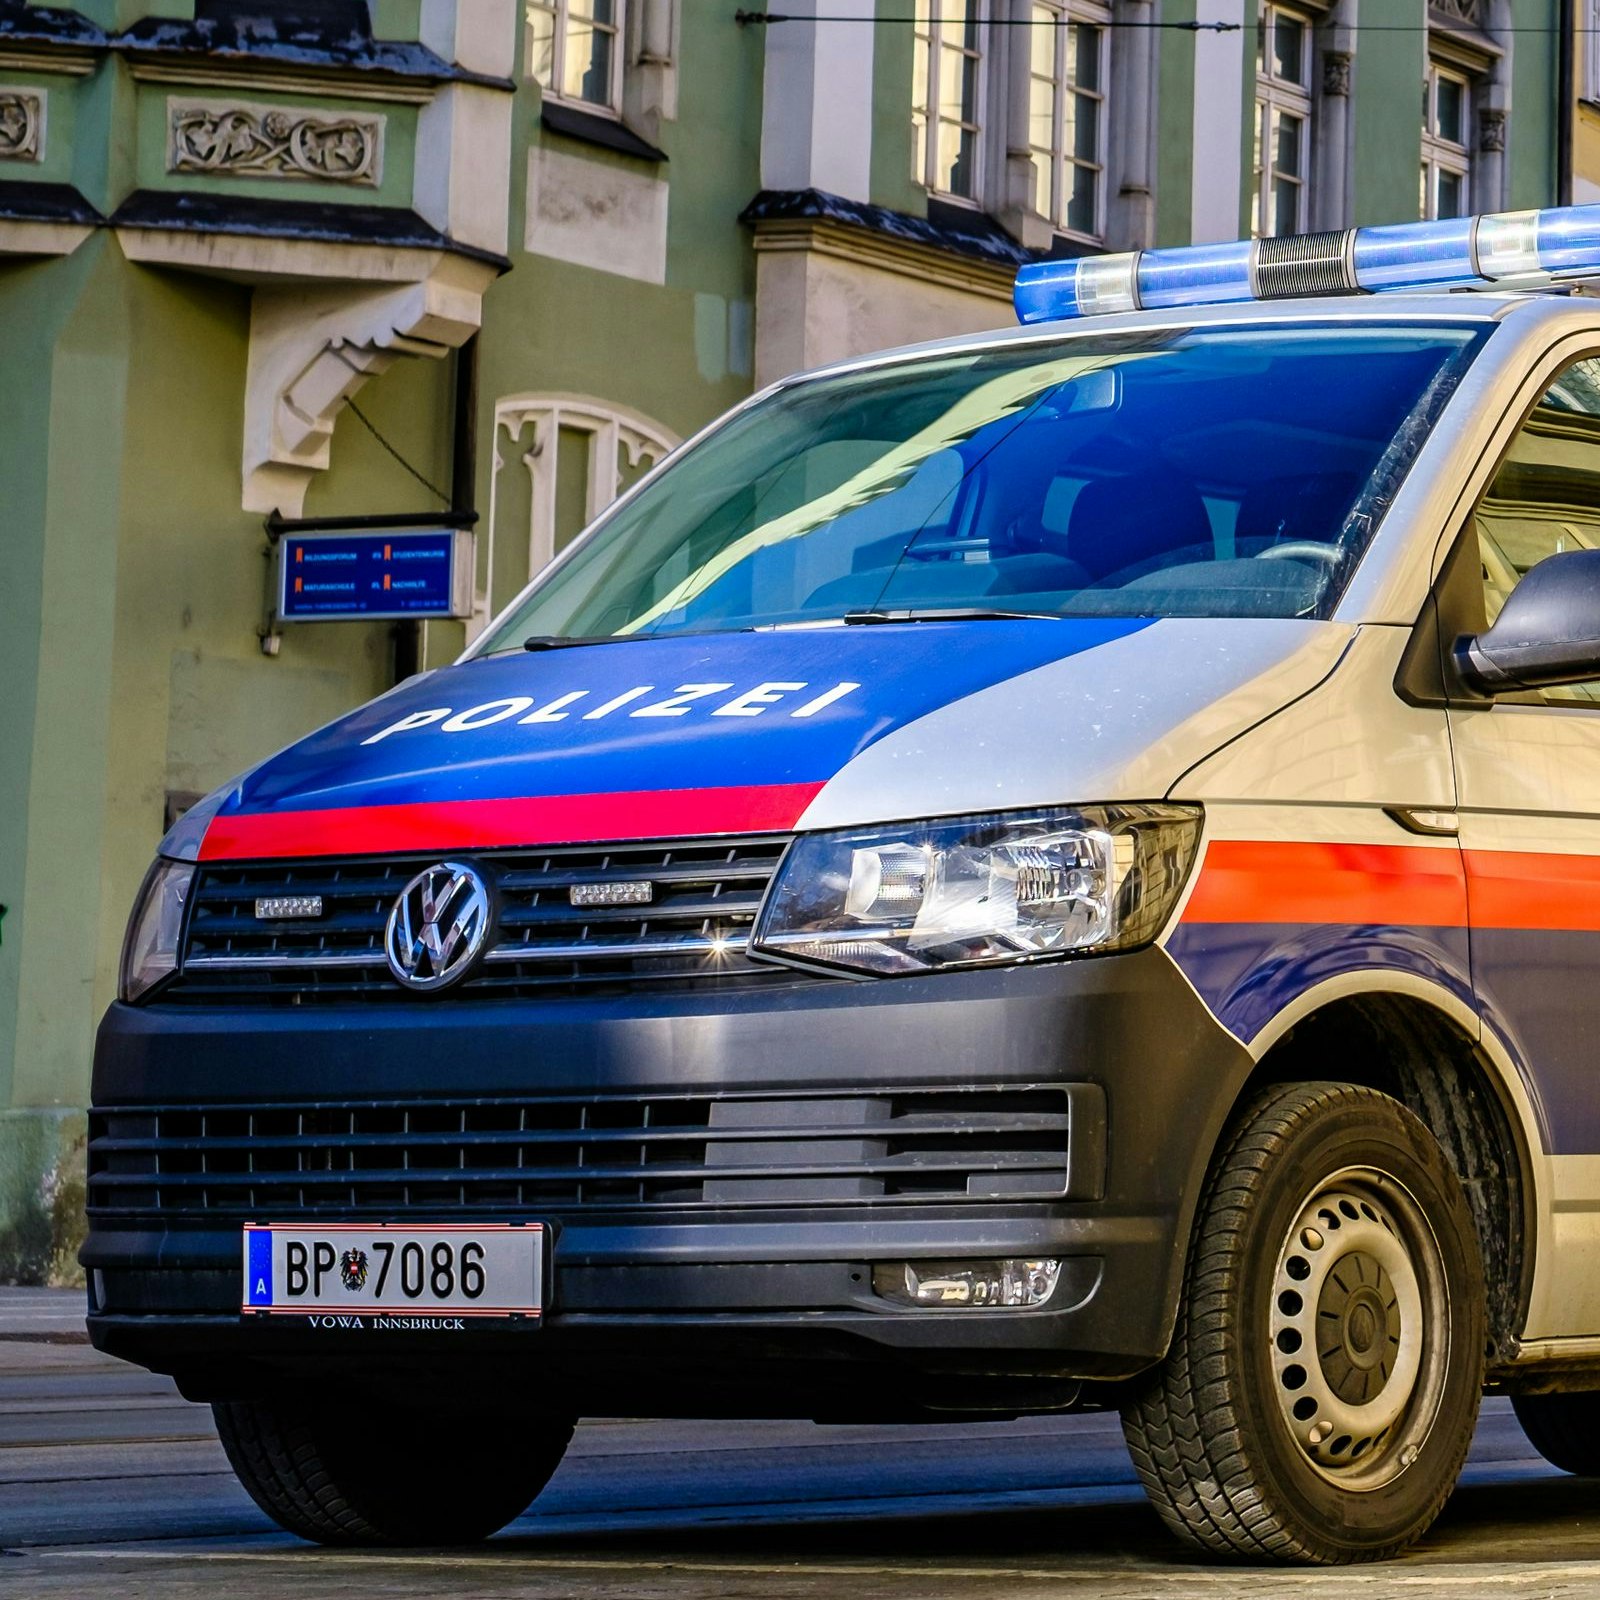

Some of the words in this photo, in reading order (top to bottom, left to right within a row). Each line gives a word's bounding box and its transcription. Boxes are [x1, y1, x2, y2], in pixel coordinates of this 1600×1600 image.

[360, 682, 861, 745] POLIZEI
[255, 1278, 266, 1296] A
[286, 1241, 337, 1298] BP
[372, 1241, 487, 1299] 7086
[308, 1315, 364, 1329] VOWA
[373, 1317, 465, 1330] INNSBRUCK
